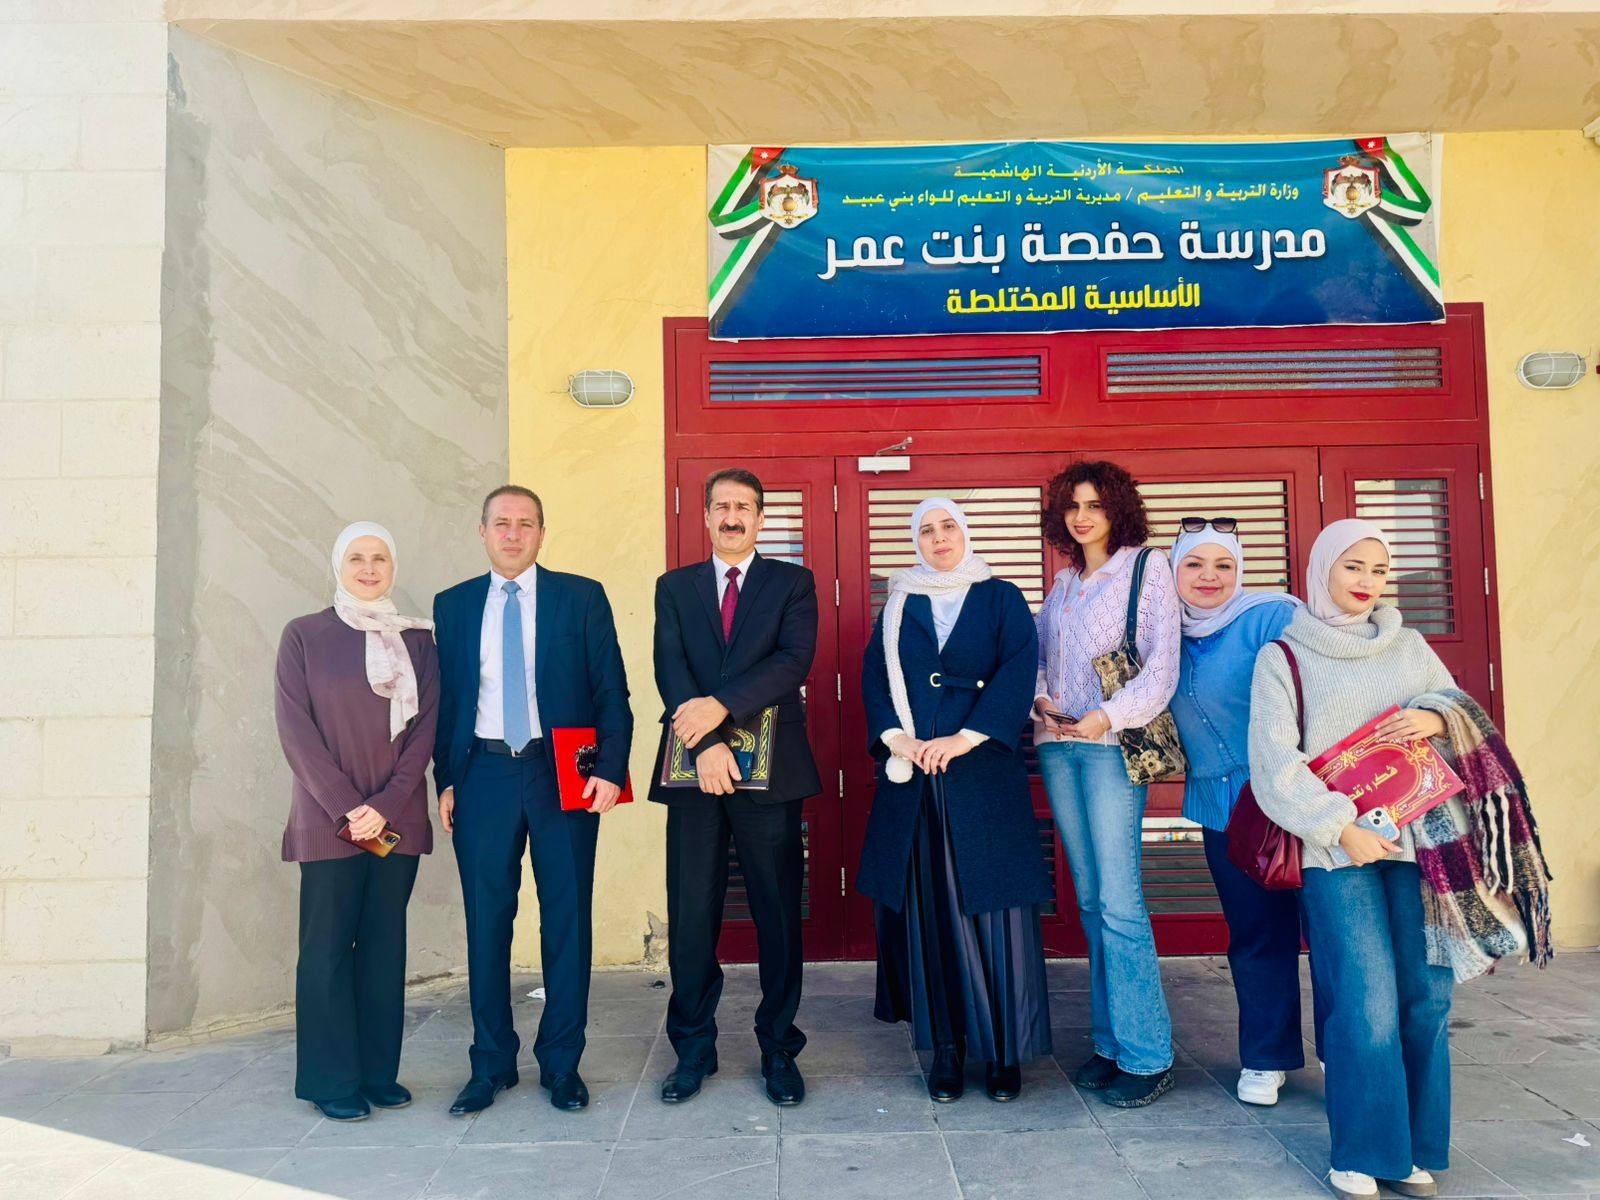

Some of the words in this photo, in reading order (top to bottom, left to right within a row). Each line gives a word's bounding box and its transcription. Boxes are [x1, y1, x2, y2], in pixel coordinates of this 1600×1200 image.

[954, 162, 1041, 180] الهاشمية
[1046, 158, 1111, 181] الأردنية
[1116, 161, 1184, 175] المملكة
[842, 193, 885, 207] عبيد
[917, 189, 954, 206] للواء
[957, 189, 1011, 207] التعليم
[1015, 193, 1022, 205] و
[1026, 187, 1071, 205] التربية
[1076, 187, 1121, 205] مديرية
[1125, 187, 1133, 201] /
[1137, 185, 1201, 205] التعليم
[1205, 189, 1212, 202] و
[1216, 182, 1266, 201] التربية
[1270, 182, 1299, 200] وزارة
[888, 191, 914, 212] بني
[921, 224, 1006, 274] بنت
[1021, 221, 1164, 263] حفصة
[1179, 220, 1326, 271] مدرسة
[816, 234, 905, 280] عمر
[946, 285, 1076, 315] المختلطة
[1084, 276, 1200, 315] الأساسية
